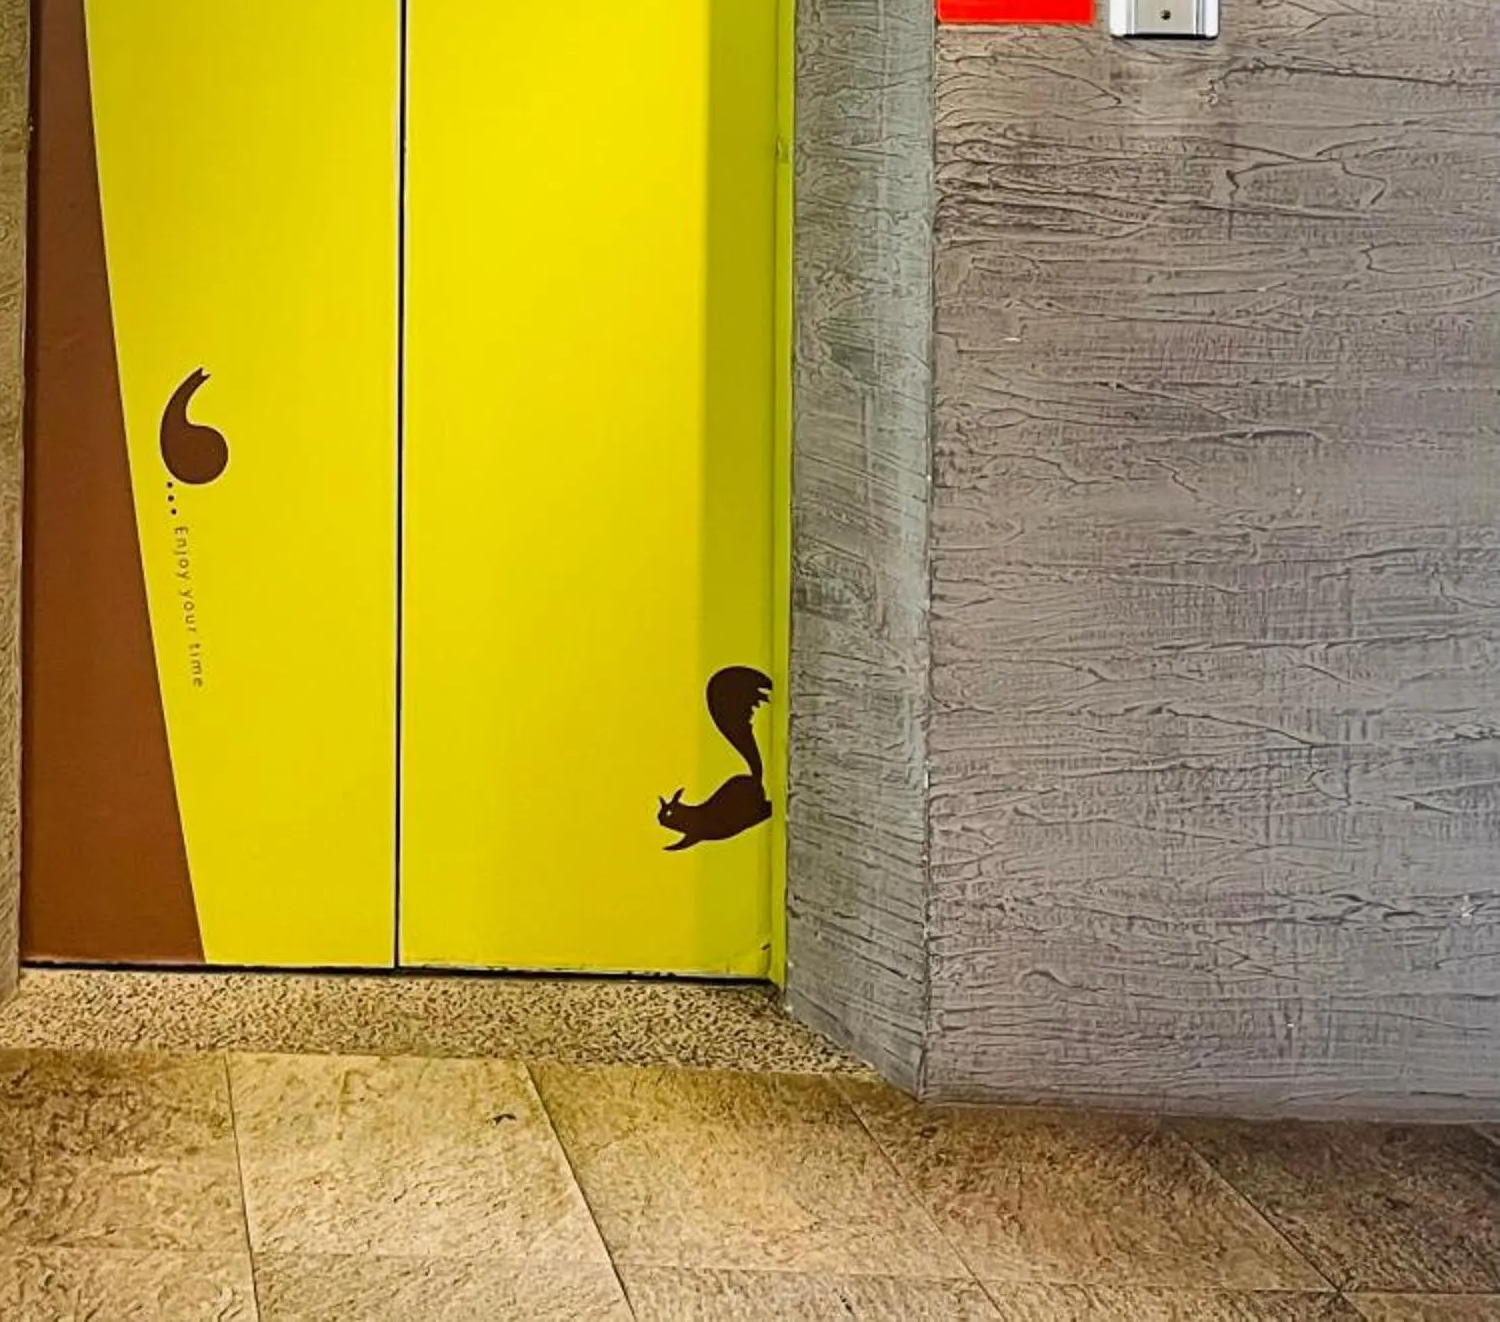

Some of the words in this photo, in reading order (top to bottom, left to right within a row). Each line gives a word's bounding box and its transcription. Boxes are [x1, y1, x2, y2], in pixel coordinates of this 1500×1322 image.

[173, 526, 190, 580] Enjoy
[179, 589, 199, 634] your
[189, 643, 204, 688] time
